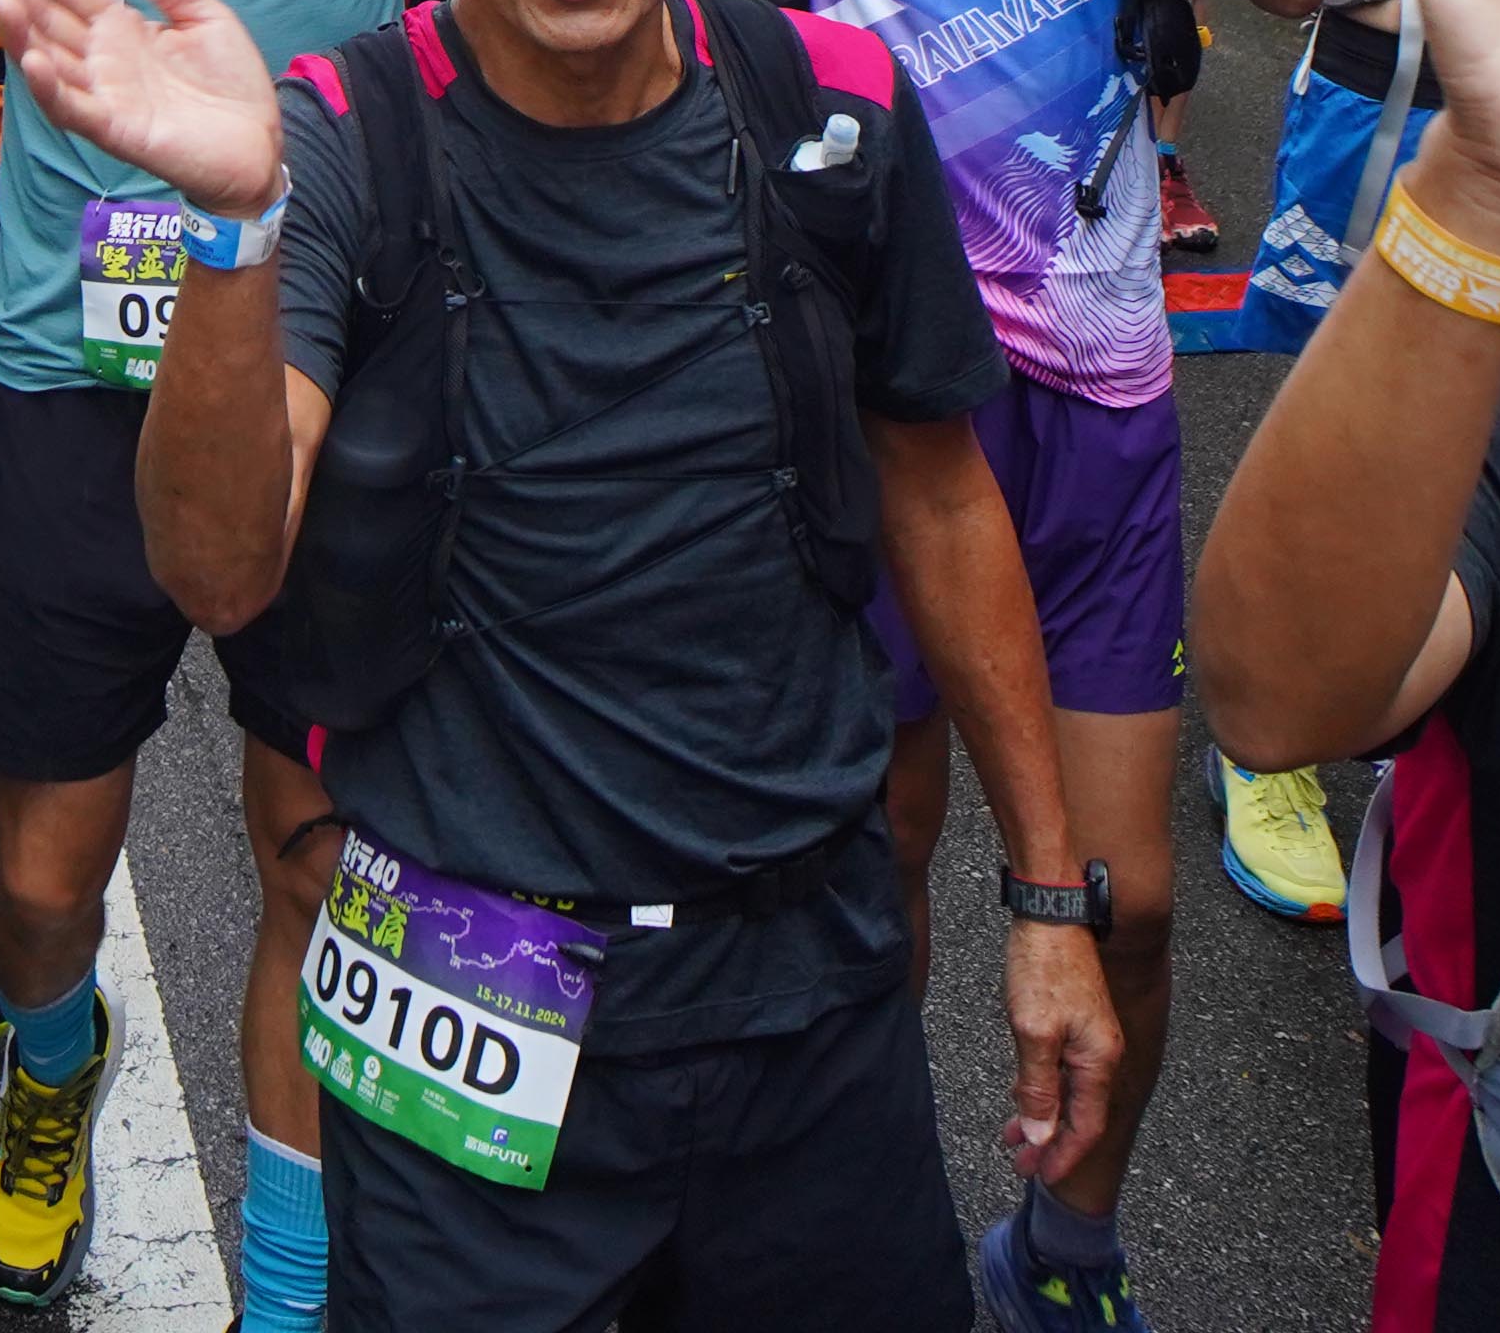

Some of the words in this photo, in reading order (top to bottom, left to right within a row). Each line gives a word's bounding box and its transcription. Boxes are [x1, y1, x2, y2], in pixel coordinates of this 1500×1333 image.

[119, 293, 177, 340] 09
[316, 936, 521, 1096] 0910D
[475, 983, 567, 1029] 15-17.11.2024
